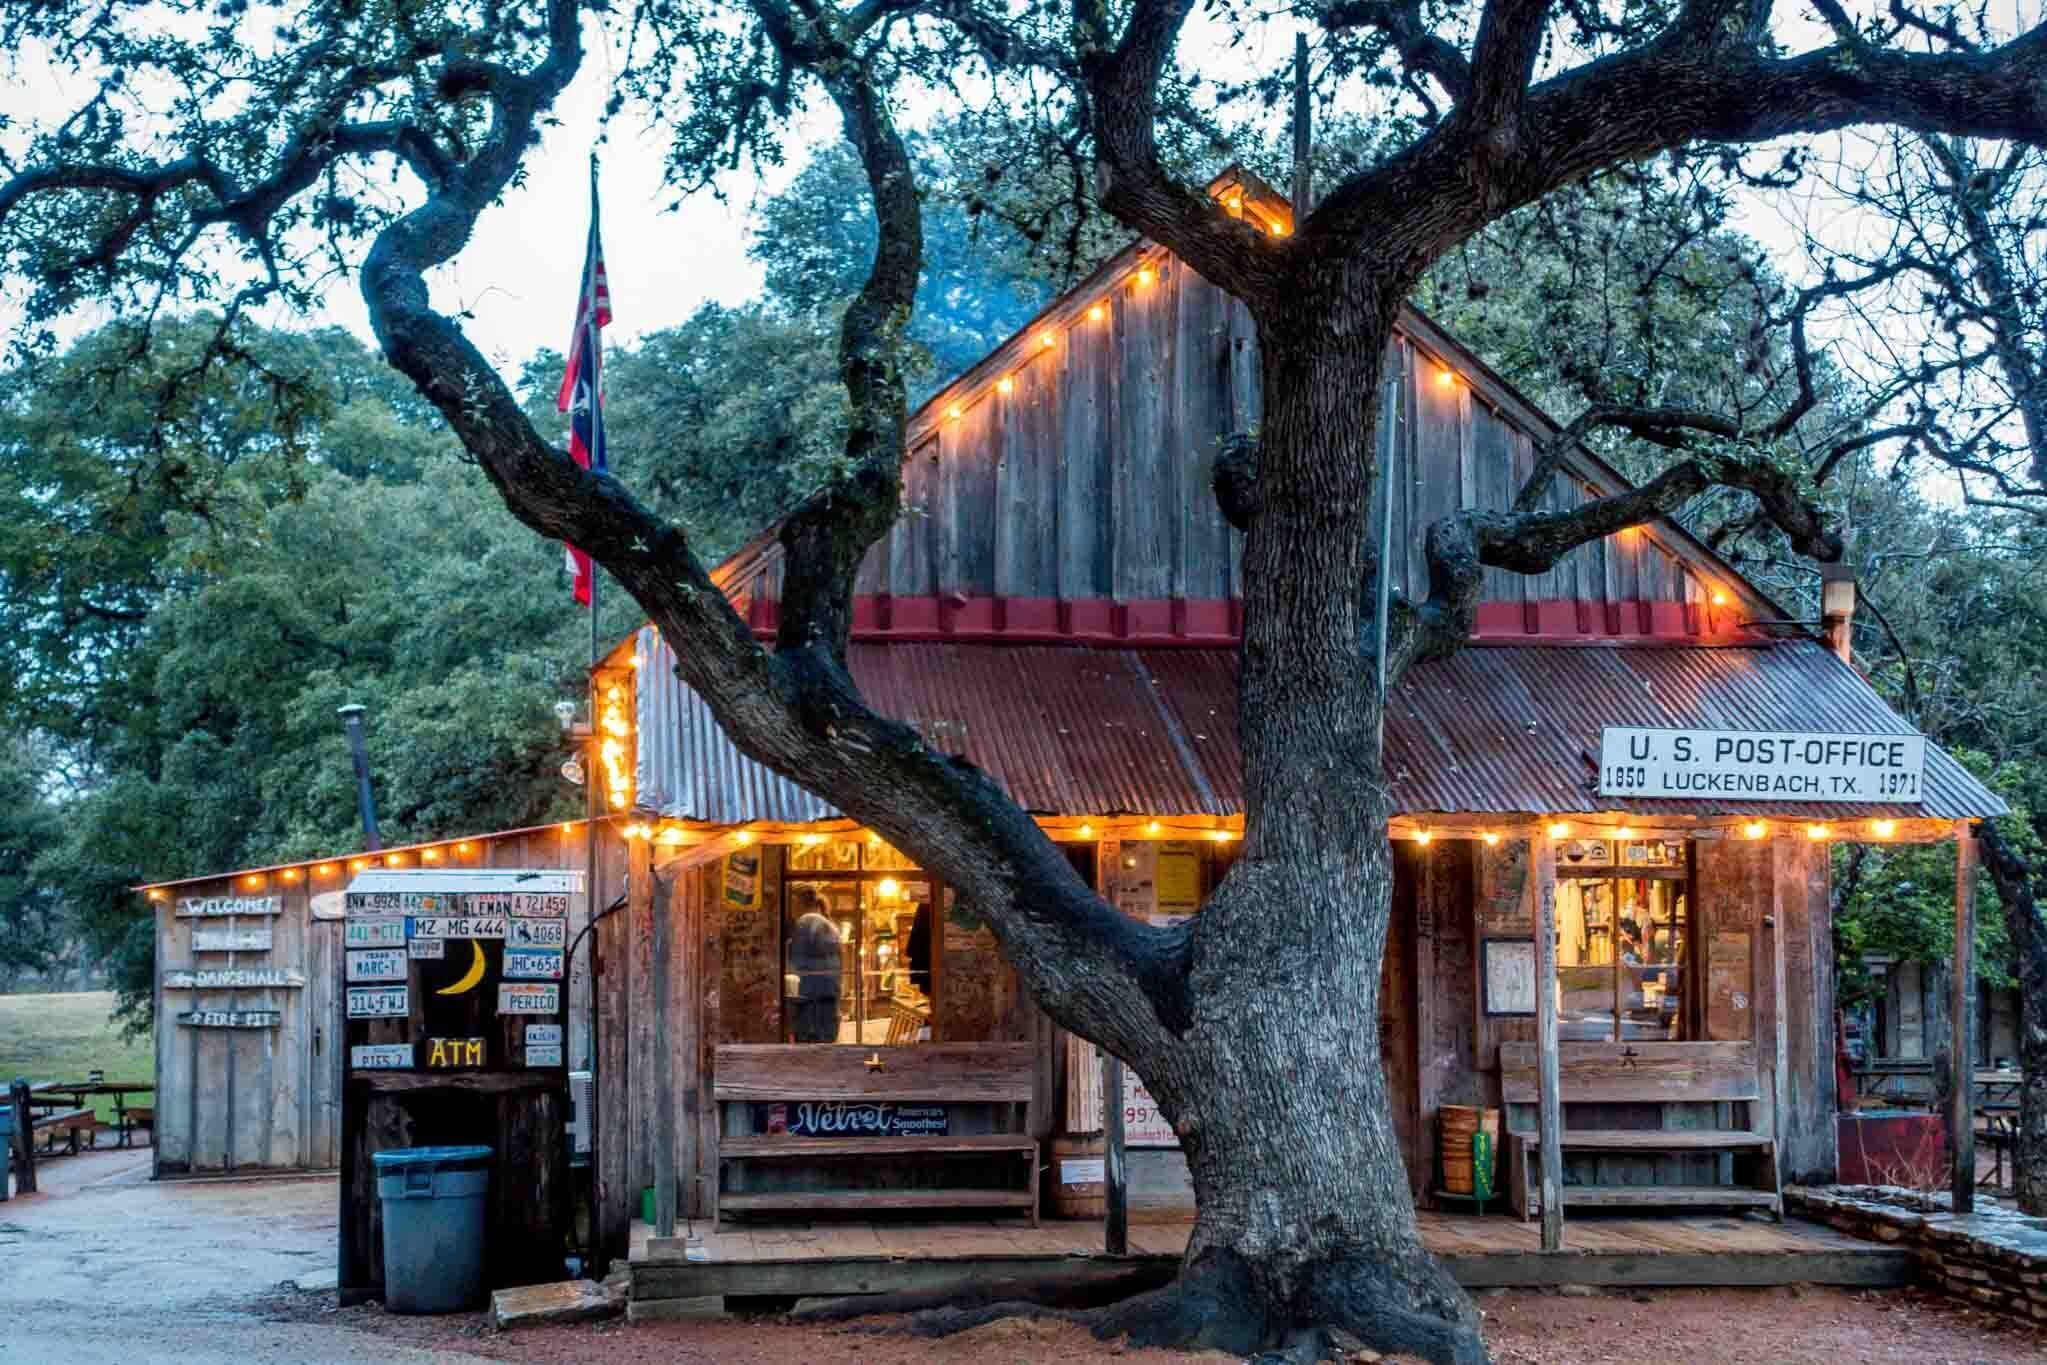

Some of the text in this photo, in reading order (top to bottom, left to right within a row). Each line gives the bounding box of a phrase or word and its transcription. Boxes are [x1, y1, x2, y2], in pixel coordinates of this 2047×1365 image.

[1630, 735, 1905, 767] U. S. POST-OFFICE
[1605, 767, 1646, 788] 1850
[1880, 773, 1917, 795] 1971
[415, 919, 437, 935] MZ
[447, 919, 469, 935] MG
[474, 919, 504, 936] 444
[510, 995, 555, 1009] PERICO
[245, 1013, 273, 1026] PIT
[430, 1038, 481, 1067] ATM
[892, 1118, 947, 1130] Smoothest
